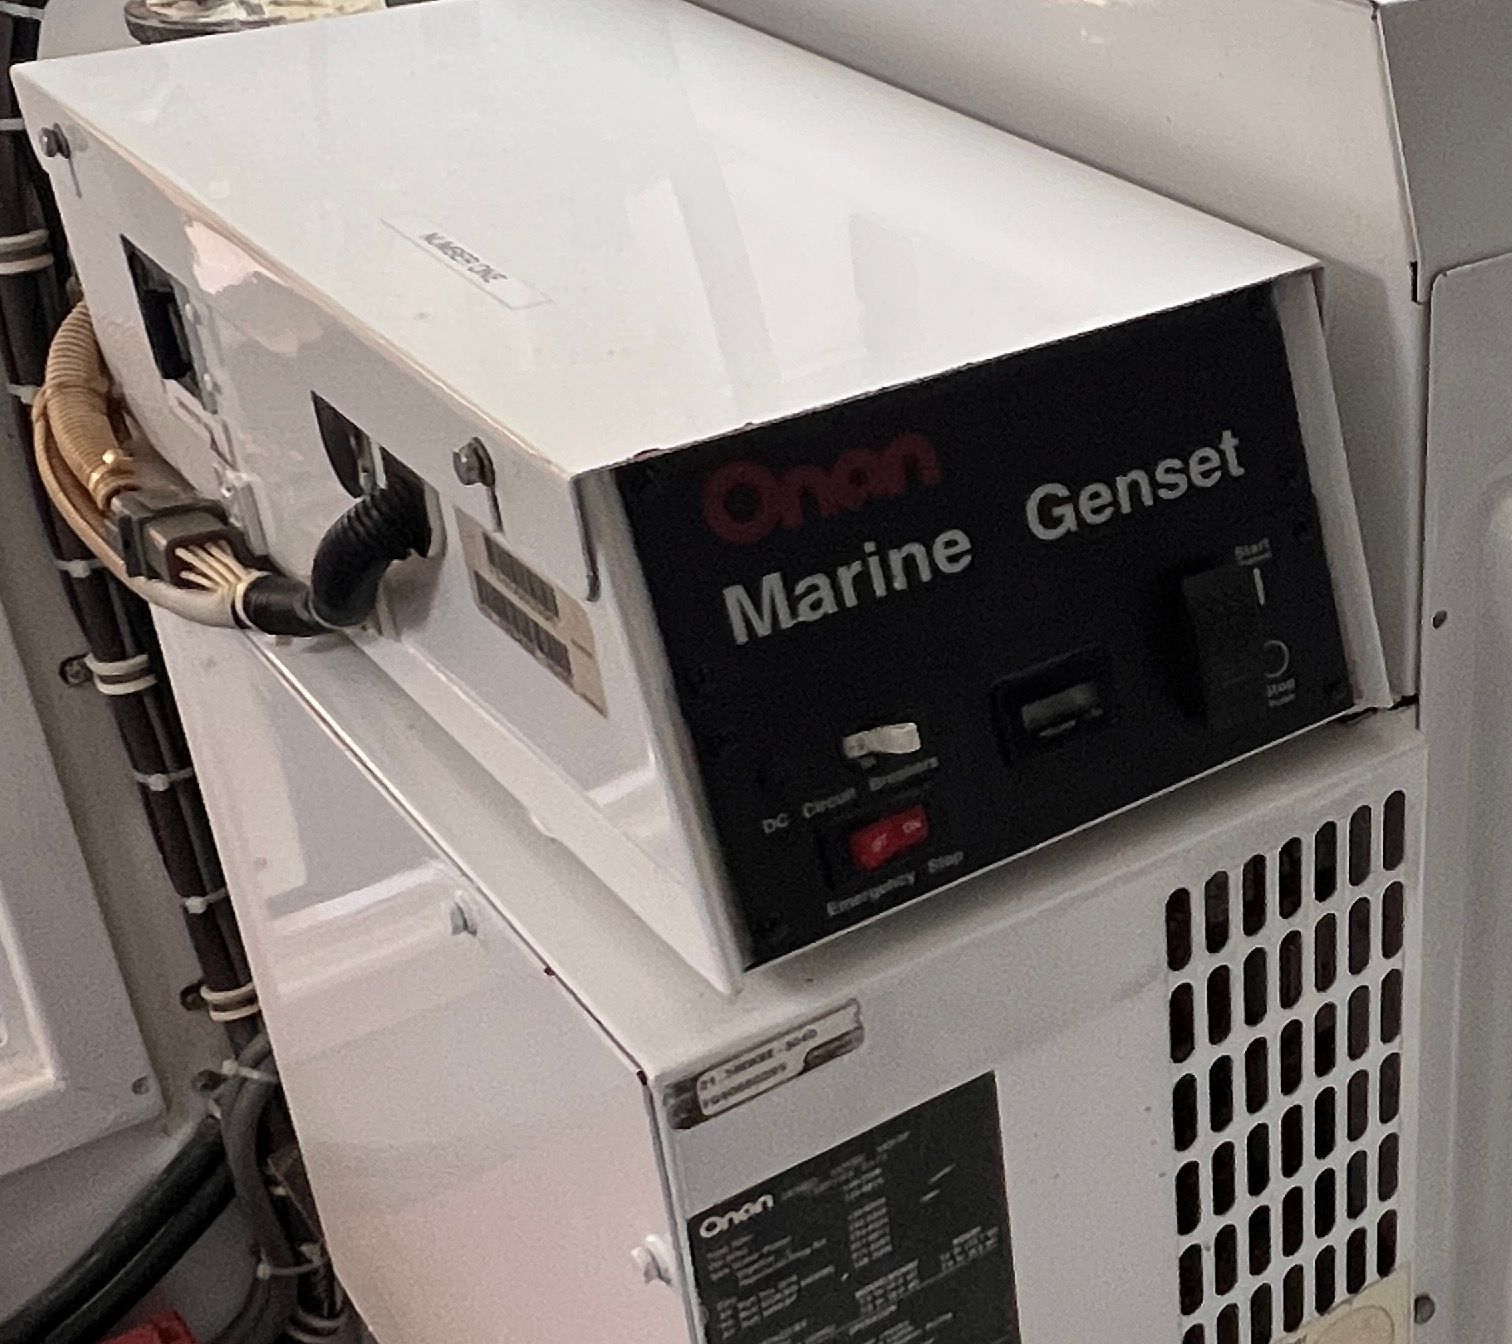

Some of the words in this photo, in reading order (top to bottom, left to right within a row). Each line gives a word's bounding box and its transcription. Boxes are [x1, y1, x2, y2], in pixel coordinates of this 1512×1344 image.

[704, 432, 942, 545] Onan
[722, 527, 973, 646] Marine
[1025, 429, 1246, 541] Genset
[762, 812, 790, 834] DC
[802, 786, 857, 819] Circuit
[826, 870, 916, 917] Emergency
[927, 850, 965, 875] Stop
[699, 1193, 774, 1239] Onan
